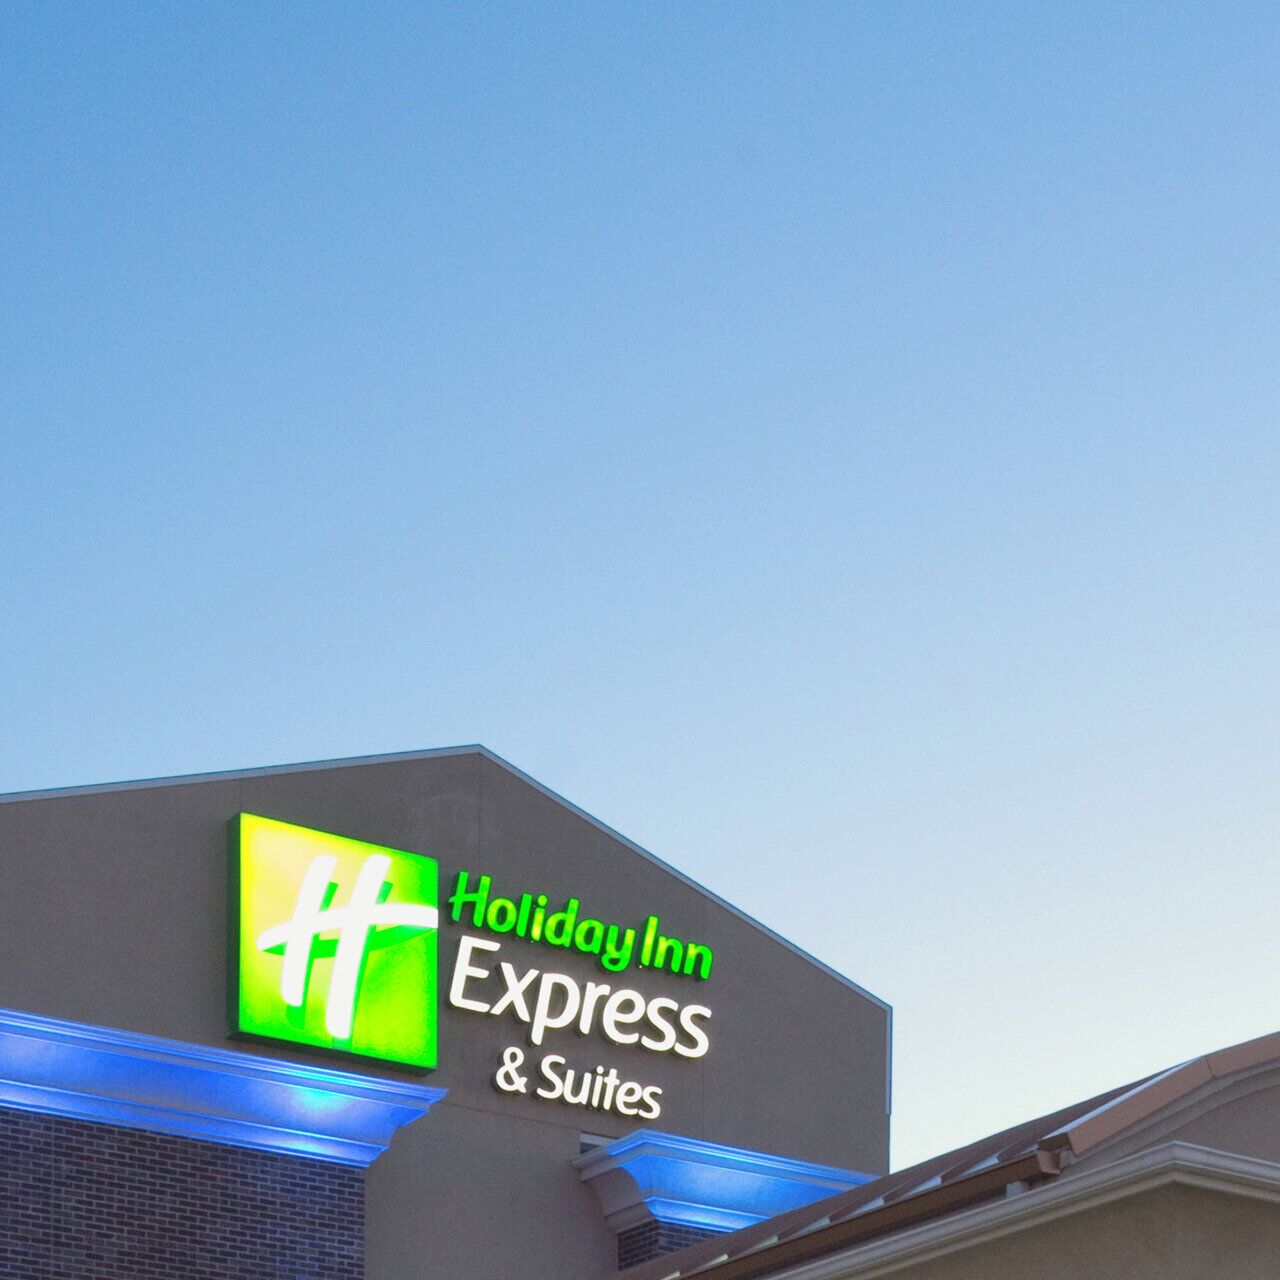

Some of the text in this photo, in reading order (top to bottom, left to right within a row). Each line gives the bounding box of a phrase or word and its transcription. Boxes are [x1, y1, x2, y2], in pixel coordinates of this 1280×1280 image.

[449, 870, 714, 980] Holiday Inn
[449, 935, 712, 1058] Express
[495, 1046, 663, 1120] & Suites
